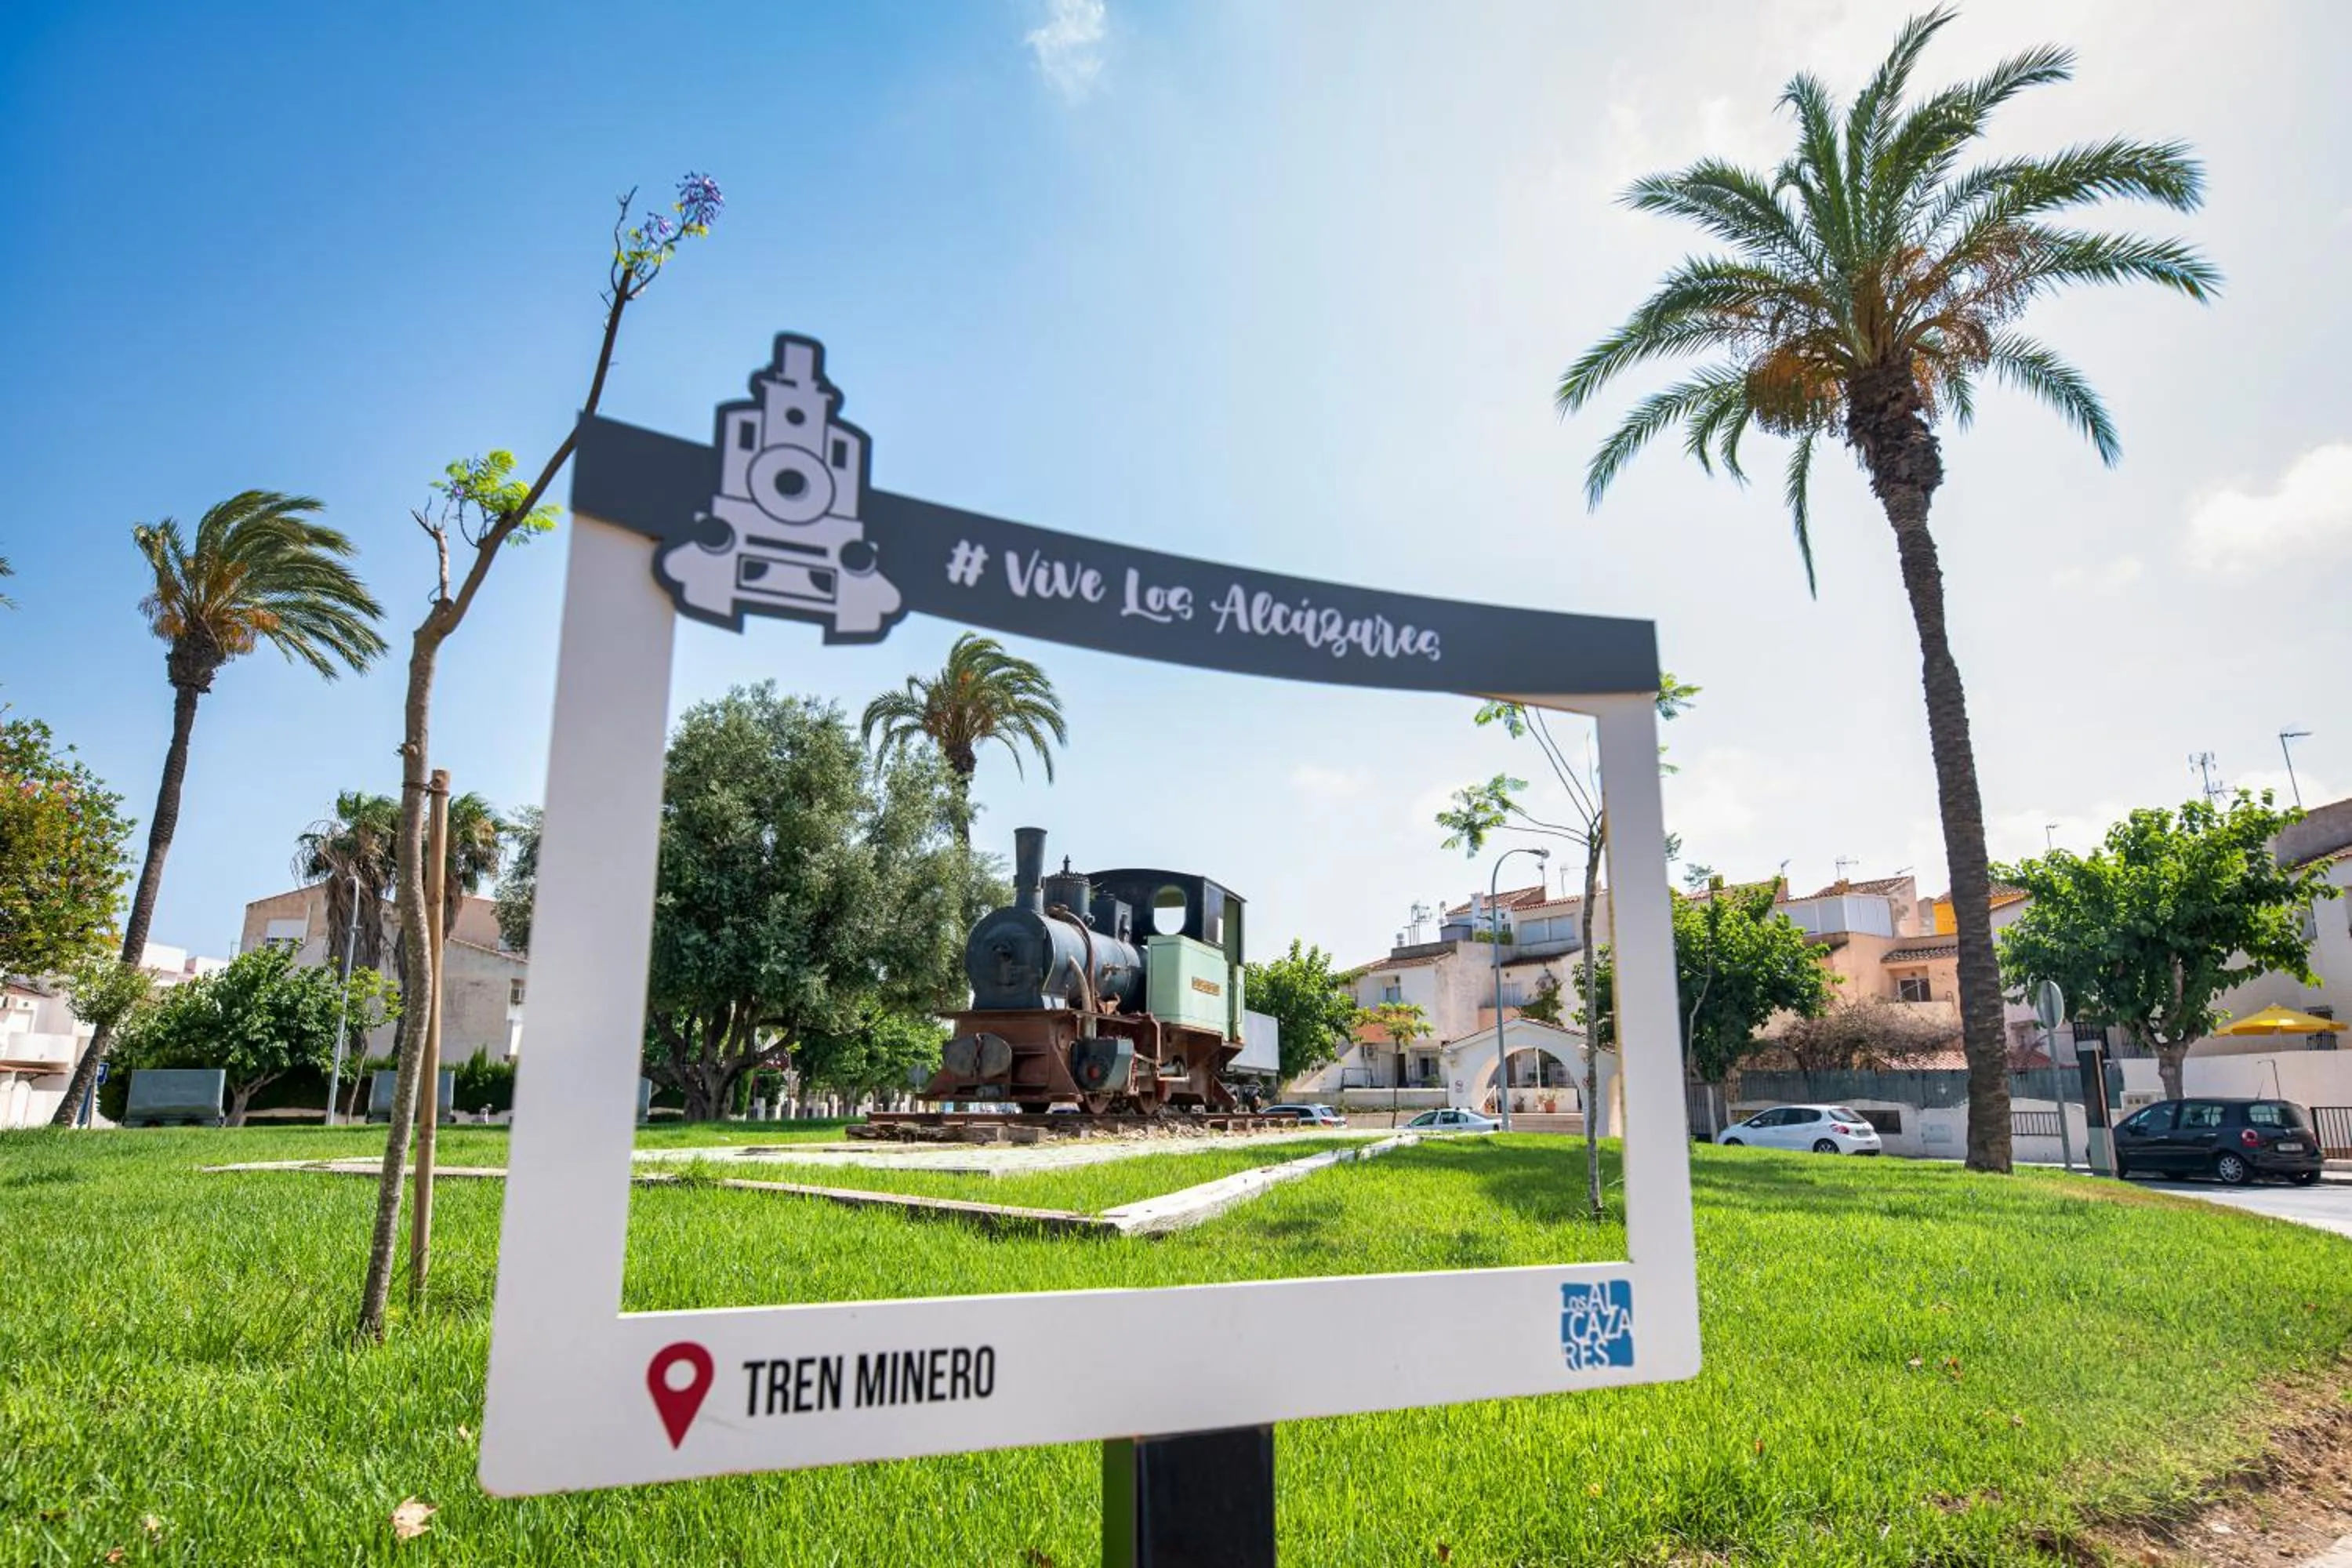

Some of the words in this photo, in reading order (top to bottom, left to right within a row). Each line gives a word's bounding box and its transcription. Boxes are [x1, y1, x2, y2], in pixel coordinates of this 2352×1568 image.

[946, 539, 989, 586] #
[1005, 550, 1105, 602] Vive
[1120, 568, 1193, 622] Los
[742, 1356, 844, 1417] TREN
[855, 1345, 995, 1409] MINERO
